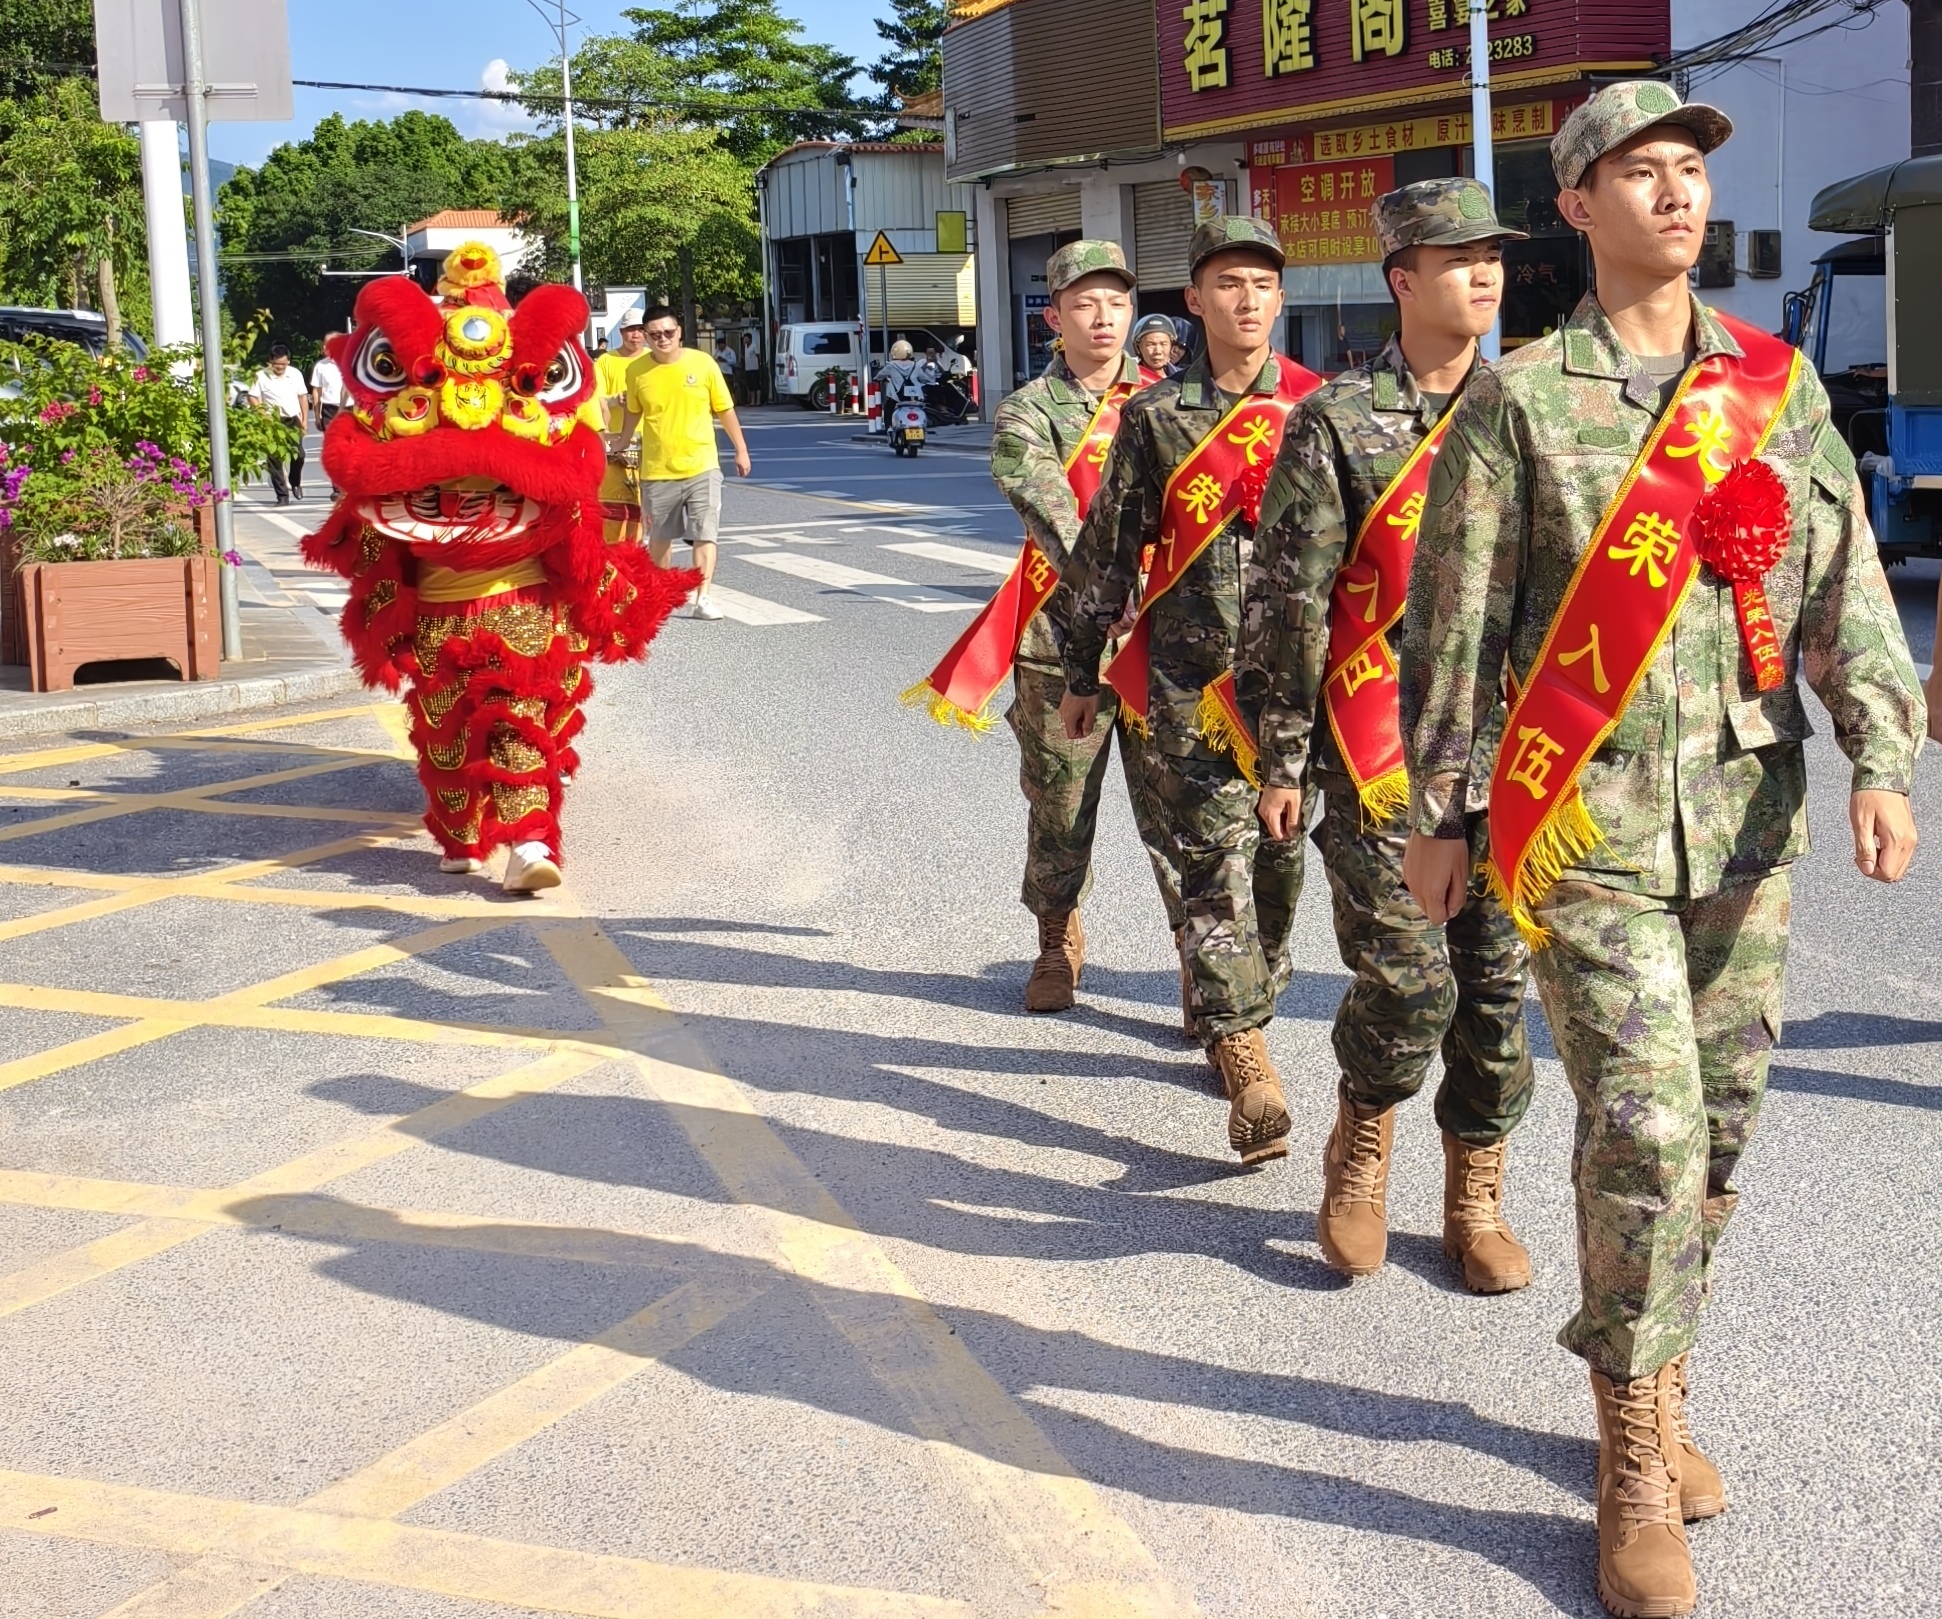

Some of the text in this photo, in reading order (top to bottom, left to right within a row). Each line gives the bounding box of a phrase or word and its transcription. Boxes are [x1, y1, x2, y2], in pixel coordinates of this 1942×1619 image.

[1429, 35, 1533, 69] 电话：223283
[1320, 104, 1546, 157] 选取乡土食材，原汁味烹制
[1301, 168, 1375, 203] 空调开放
[1516, 262, 1558, 285] 冷气
[1741, 588, 1780, 663] 光荣入伍
